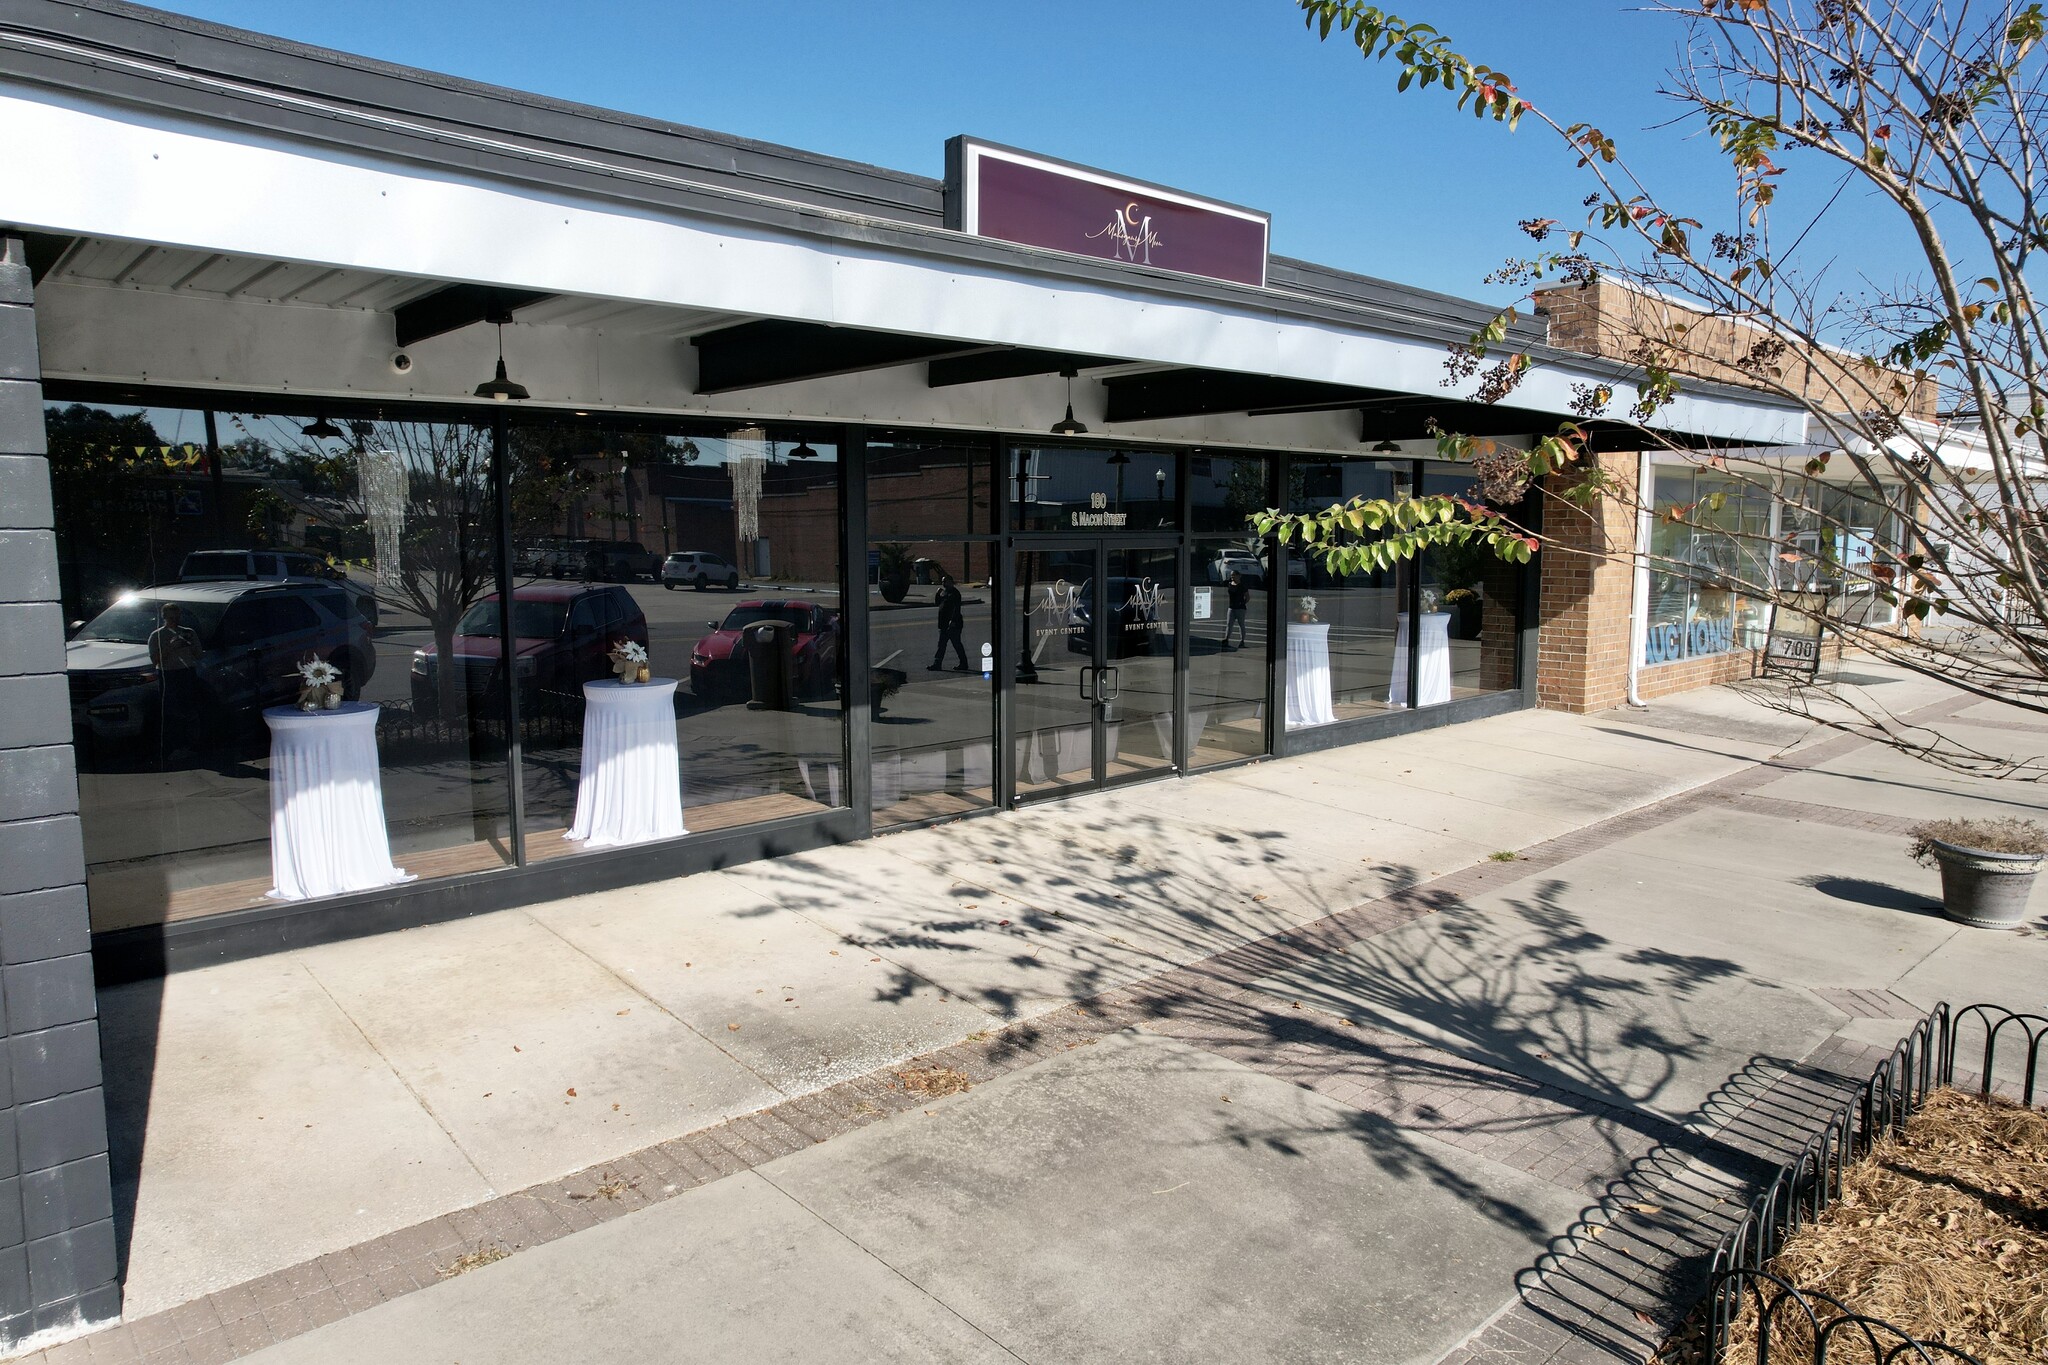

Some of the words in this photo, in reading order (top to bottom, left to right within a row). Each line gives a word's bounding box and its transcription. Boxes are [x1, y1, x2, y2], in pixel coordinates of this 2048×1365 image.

[1091, 492, 1107, 509] 180
[1036, 628, 1058, 637] EVENT
[1060, 626, 1086, 635] CENTER
[1125, 623, 1145, 631] EVENT
[1784, 639, 1813, 658] 7.00
